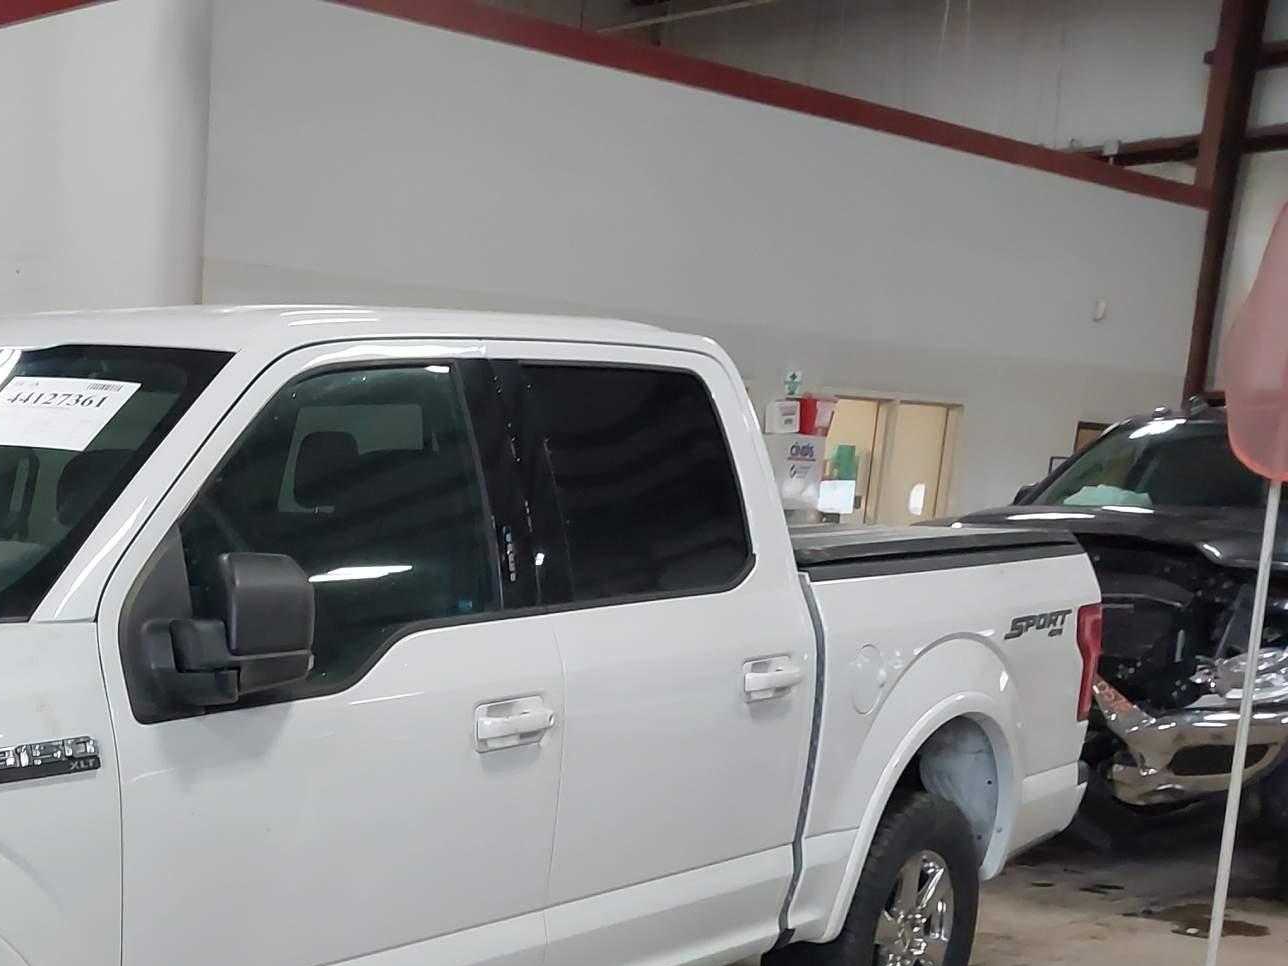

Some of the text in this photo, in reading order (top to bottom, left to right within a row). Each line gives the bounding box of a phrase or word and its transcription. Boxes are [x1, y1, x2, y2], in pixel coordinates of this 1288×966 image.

[6, 391, 108, 409] 44127361
[1004, 609, 1073, 640] SPORT
[69, 758, 95, 771] XLT
